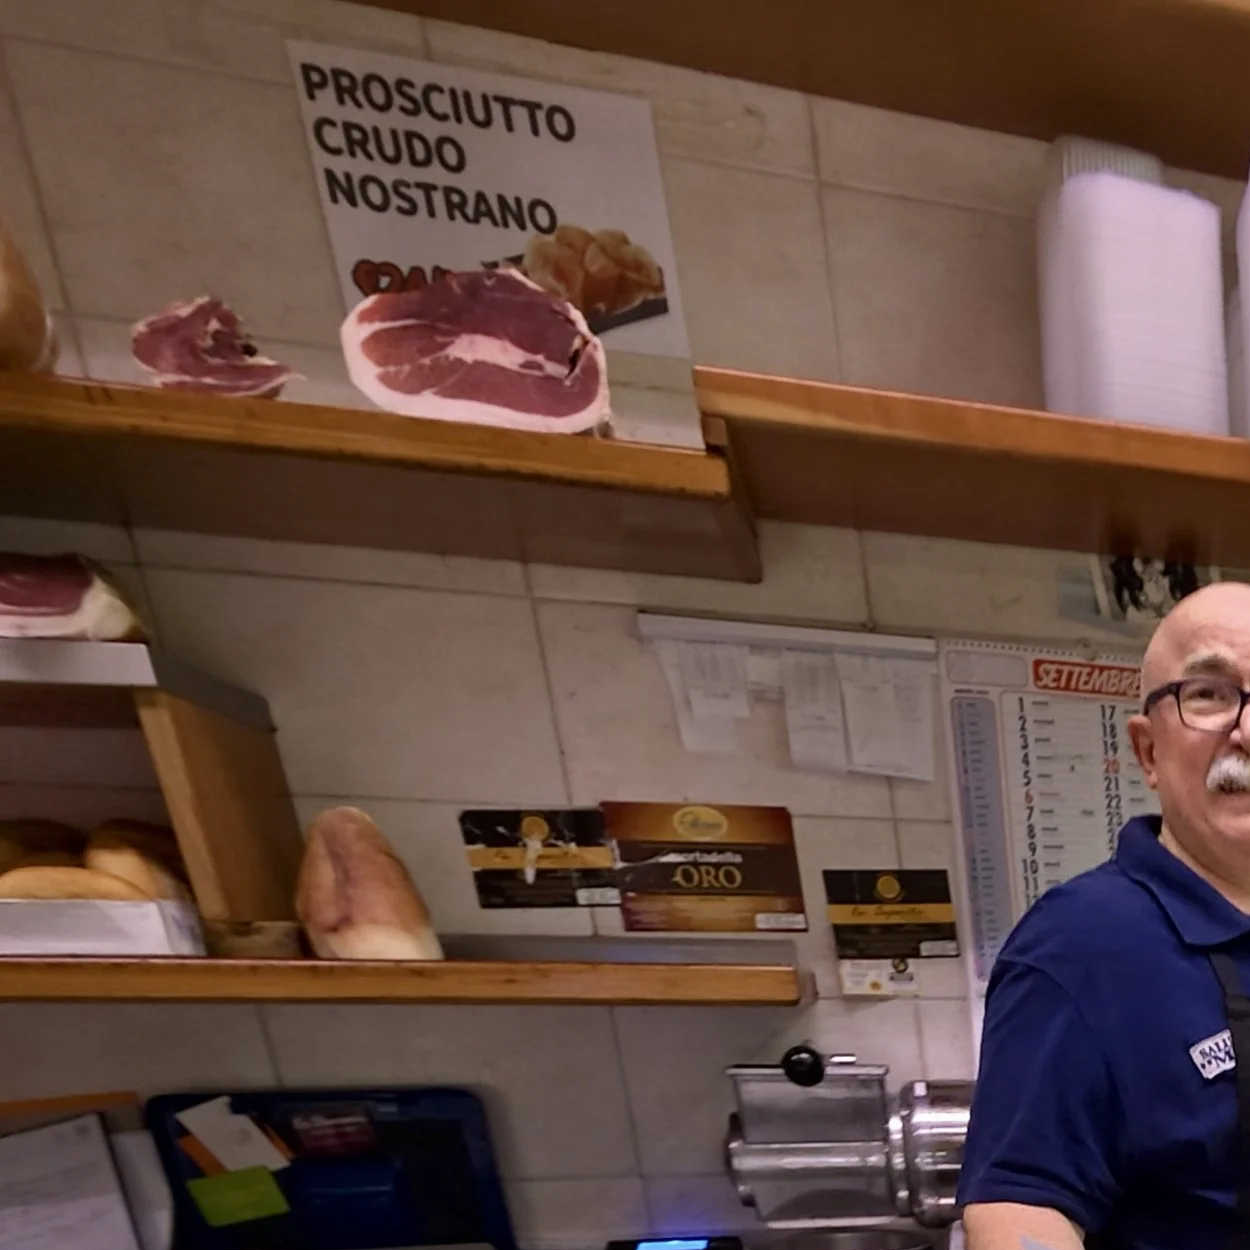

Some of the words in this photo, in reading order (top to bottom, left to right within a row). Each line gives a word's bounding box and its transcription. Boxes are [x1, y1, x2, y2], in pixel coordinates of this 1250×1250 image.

[301, 62, 576, 143] PROSCIUTTO
[313, 117, 466, 174] CRUDO
[323, 168, 558, 235] NOSTRANO
[1100, 704, 1117, 720] 17
[1018, 715, 1027, 731] 2
[1102, 722, 1118, 738] 18
[1020, 734, 1029, 750] 3
[1103, 740, 1119, 755] 19
[1022, 752, 1030, 767] 4
[1023, 770, 1032, 786] 5
[1104, 776, 1120, 792] 21
[1105, 794, 1122, 809] 22
[1026, 806, 1035, 821] 7
[1027, 824, 1036, 839] 8
[1028, 842, 1037, 857] 9
[1022, 859, 1039, 874] 10
[674, 865, 743, 888] ORO
